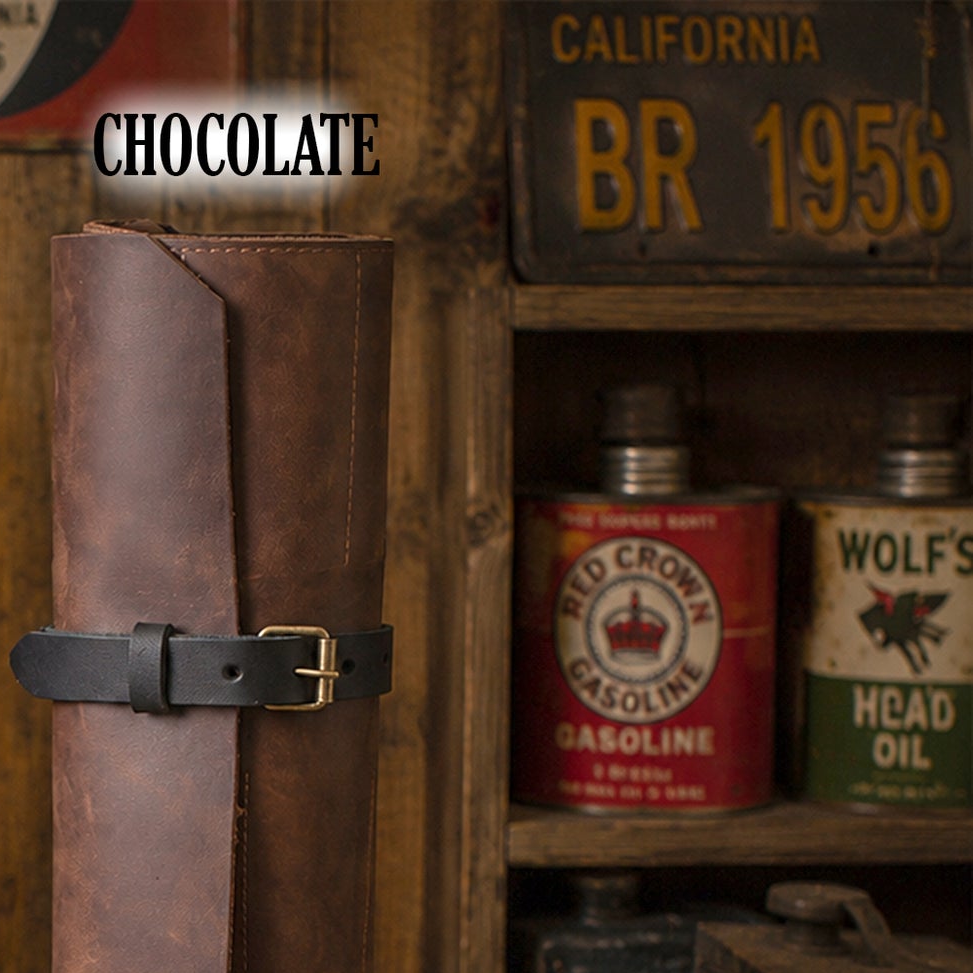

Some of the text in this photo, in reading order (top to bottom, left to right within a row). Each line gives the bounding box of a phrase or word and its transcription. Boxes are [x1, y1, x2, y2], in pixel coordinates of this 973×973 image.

[551, 14, 821, 64] CALIFORNIA
[574, 98, 952, 235] BR 1956
[838, 527, 973, 574] WOLF'S
[562, 545, 714, 625] RED CROWN
[569, 658, 703, 714] GASOLINE
[555, 723, 714, 756] GASOLINE
[873, 732, 931, 770] OIL
